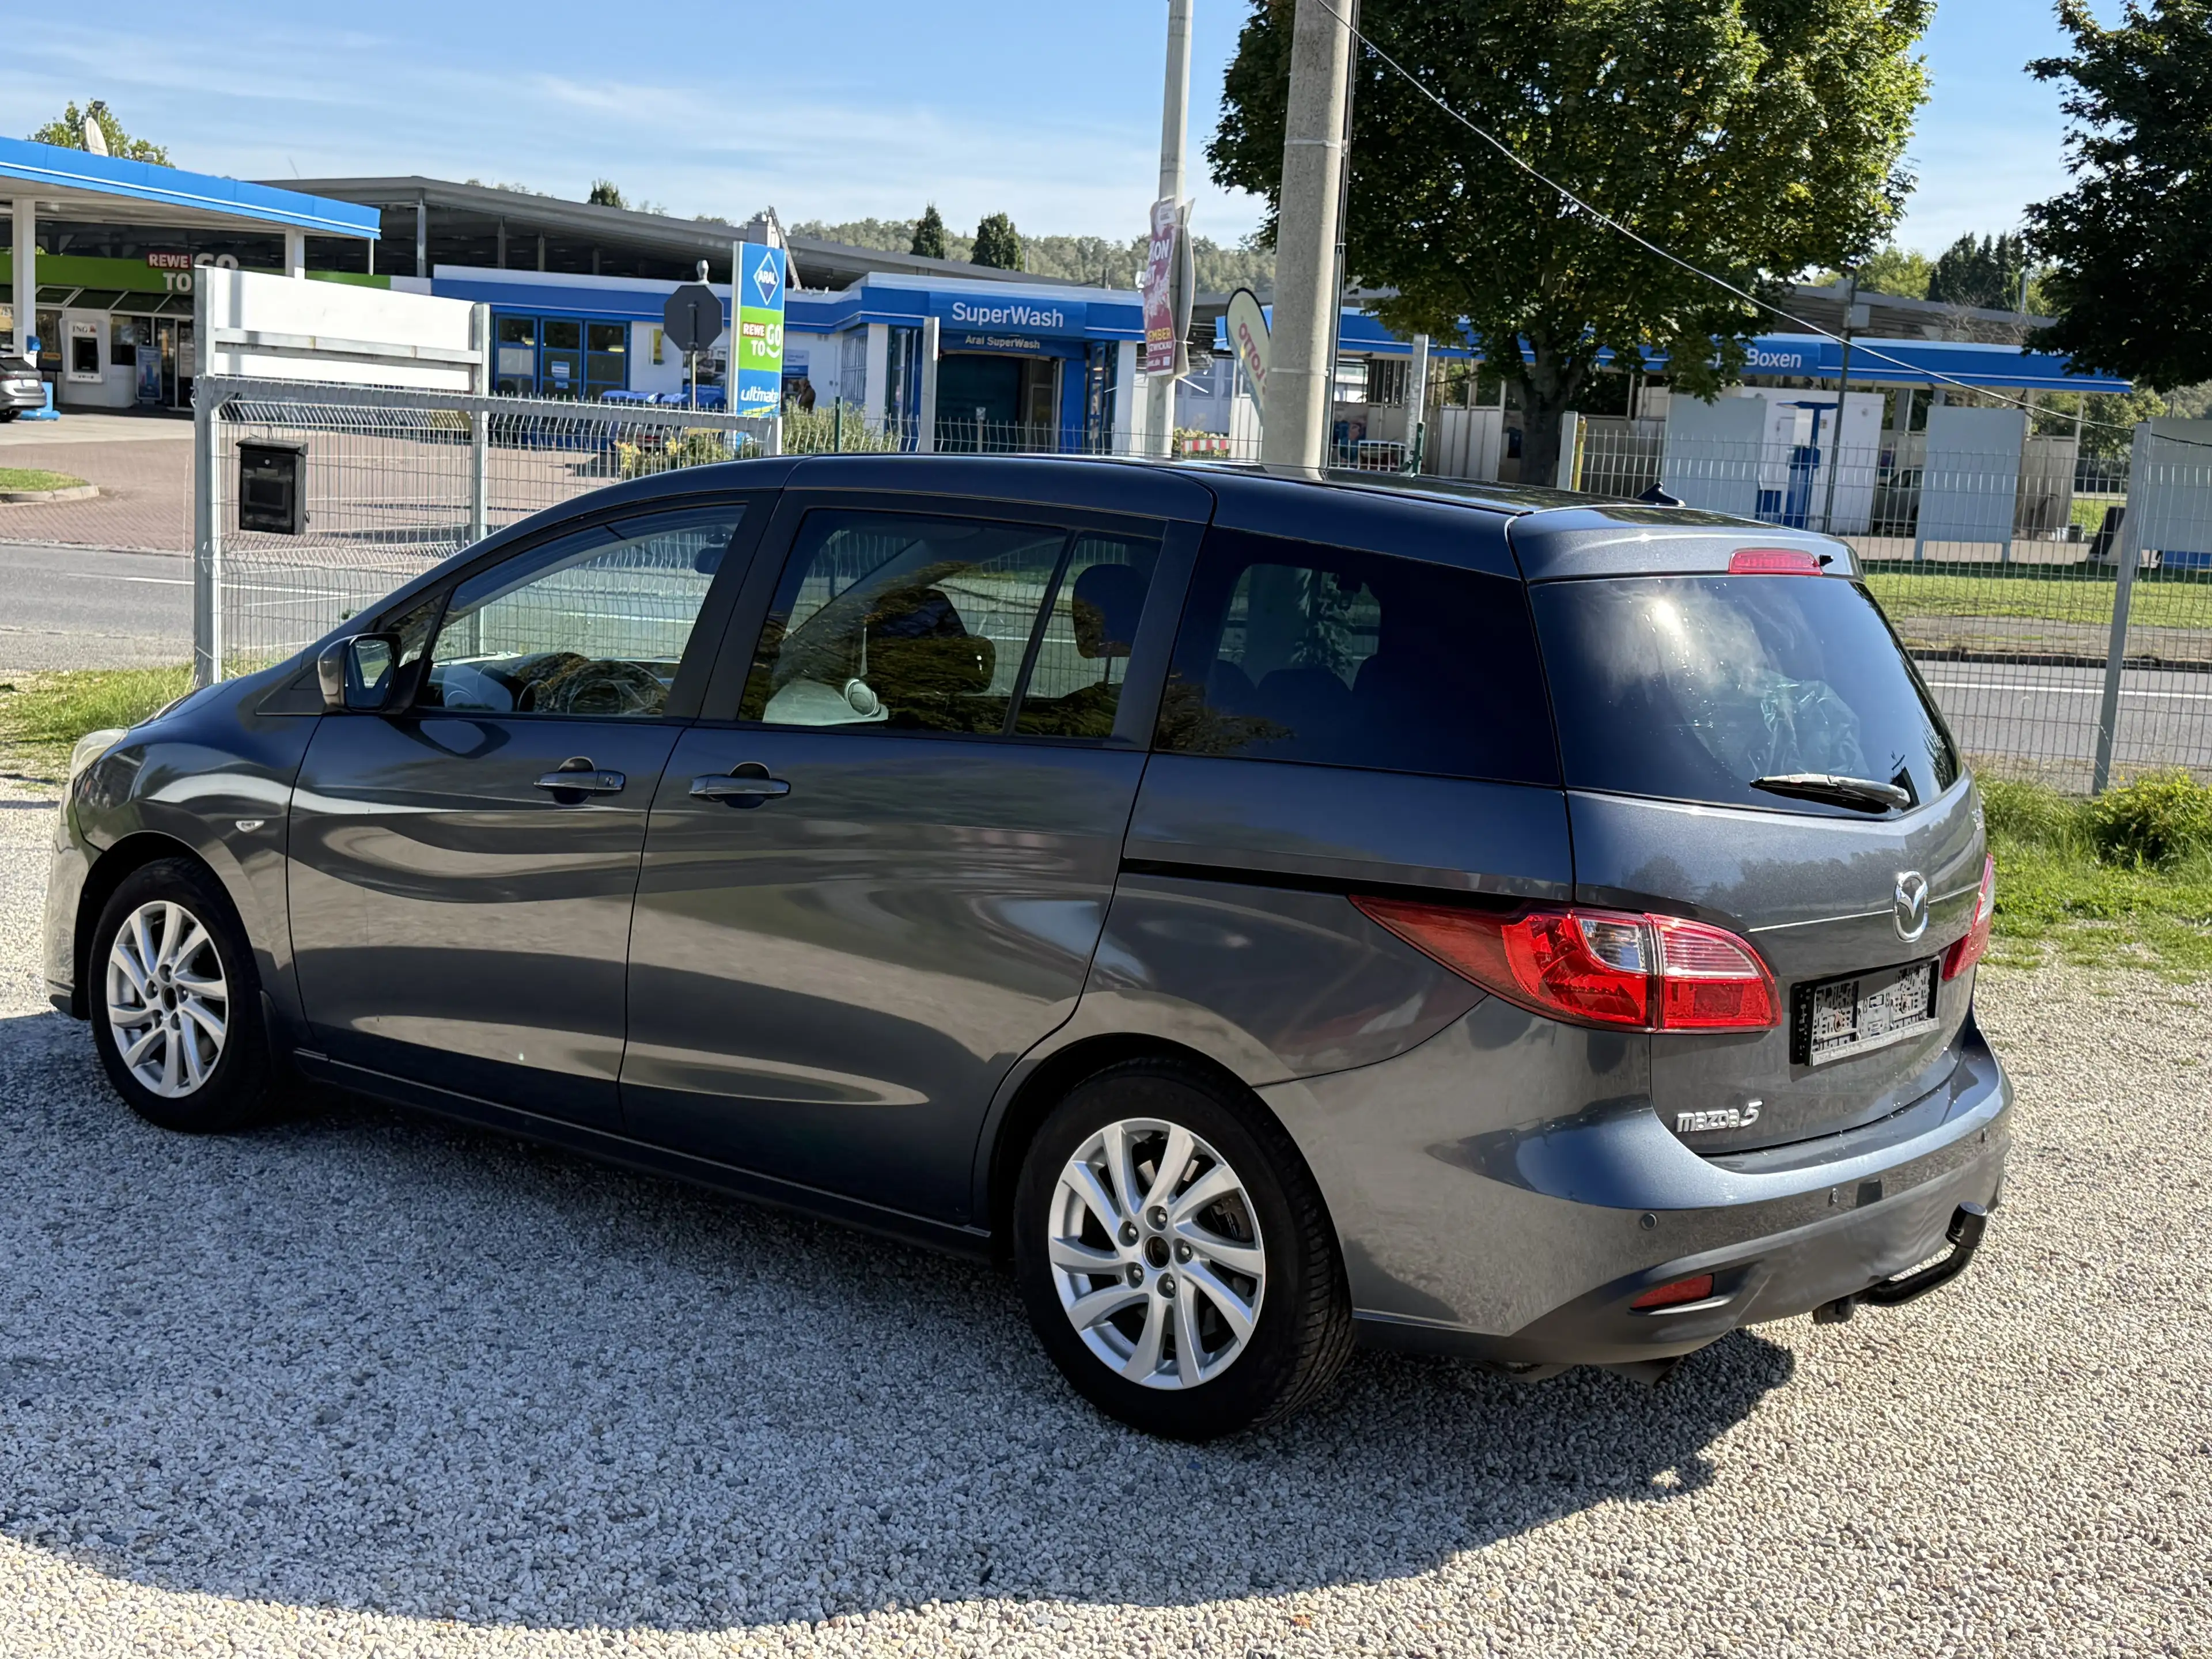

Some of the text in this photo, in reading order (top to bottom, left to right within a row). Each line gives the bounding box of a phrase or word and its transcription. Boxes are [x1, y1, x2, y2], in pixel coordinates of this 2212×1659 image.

[149, 253, 188, 268] REWE
[163, 272, 192, 291] TO
[758, 270, 776, 285] ARAL
[952, 302, 1063, 327] SuperWash
[743, 323, 782, 346] REWE GO
[965, 335, 1040, 349] Aral SuperWash
[751, 340, 766, 356] TO
[1745, 348, 1801, 368] Boxen
[741, 386, 779, 403] ultimate
